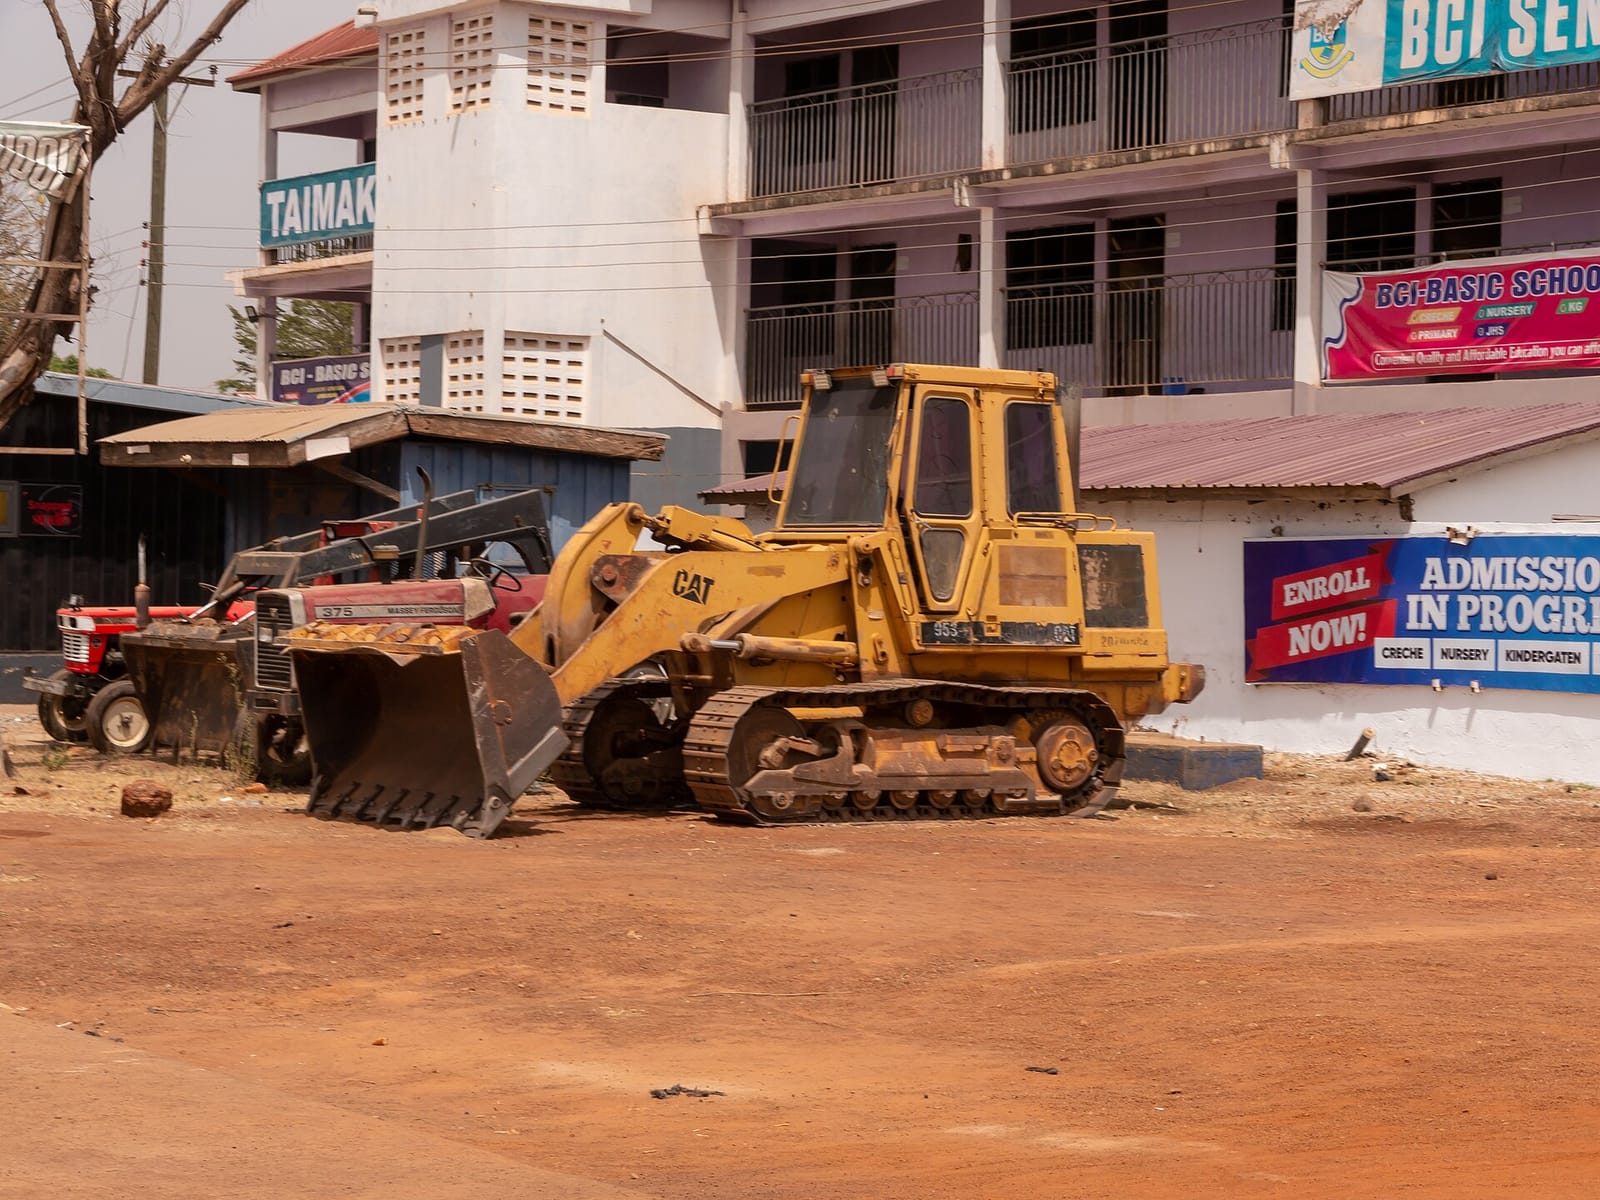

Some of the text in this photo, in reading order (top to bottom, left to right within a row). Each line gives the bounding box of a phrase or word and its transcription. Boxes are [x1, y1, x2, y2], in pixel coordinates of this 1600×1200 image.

[1400, 0, 1600, 69] BCI SEN
[266, 175, 376, 237] TAIMAK
[1376, 264, 1600, 308] BCI-BASIC SCHOO
[1486, 304, 1533, 317] NURSERY
[1568, 302, 1583, 312] KG
[1418, 326, 1504, 340] PRIMARY JHS
[1416, 351, 1444, 365] Quality
[1446, 350, 1461, 362] and
[1463, 347, 1507, 361] Affordable
[1509, 345, 1548, 358] Education
[1549, 347, 1566, 359] you
[1567, 345, 1582, 355] can
[280, 367, 305, 386] BCI
[315, 362, 358, 382] BASIC
[673, 569, 715, 605] CAT
[1283, 567, 1371, 607] ENROLL
[1420, 556, 1600, 592] ADMISSIO
[323, 607, 353, 617] 375
[388, 606, 418, 614] MASSEY
[1406, 594, 1449, 631] IN
[1288, 612, 1367, 657] NOW!
[1382, 647, 1581, 664] CRECHE NURSERY KINDERGATEN
